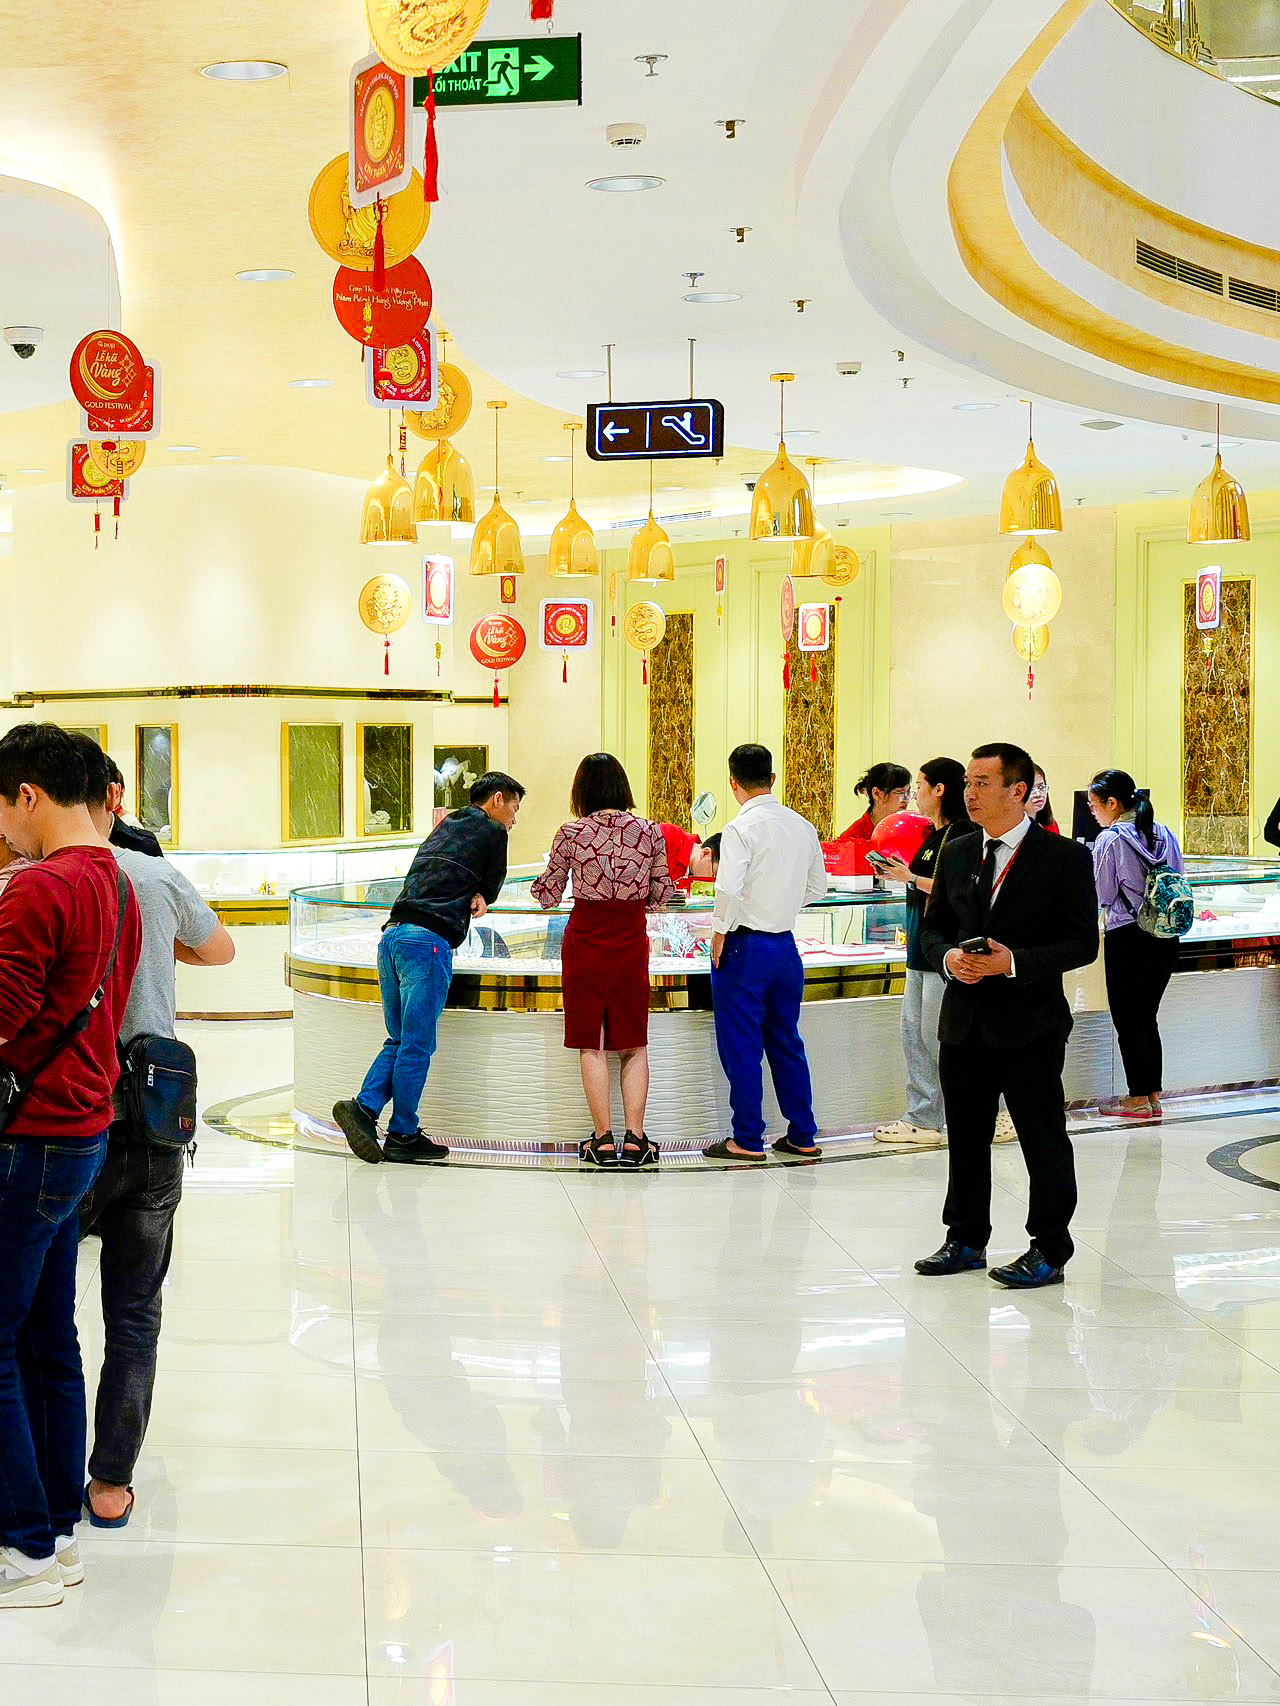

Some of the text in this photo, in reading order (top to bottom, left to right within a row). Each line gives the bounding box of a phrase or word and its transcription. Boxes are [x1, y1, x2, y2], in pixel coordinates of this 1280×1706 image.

[432, 76, 482, 93] ỐI THOÁT
[90, 361, 123, 387] Vàng
[84, 401, 133, 411] GOLD FESTIVAL
